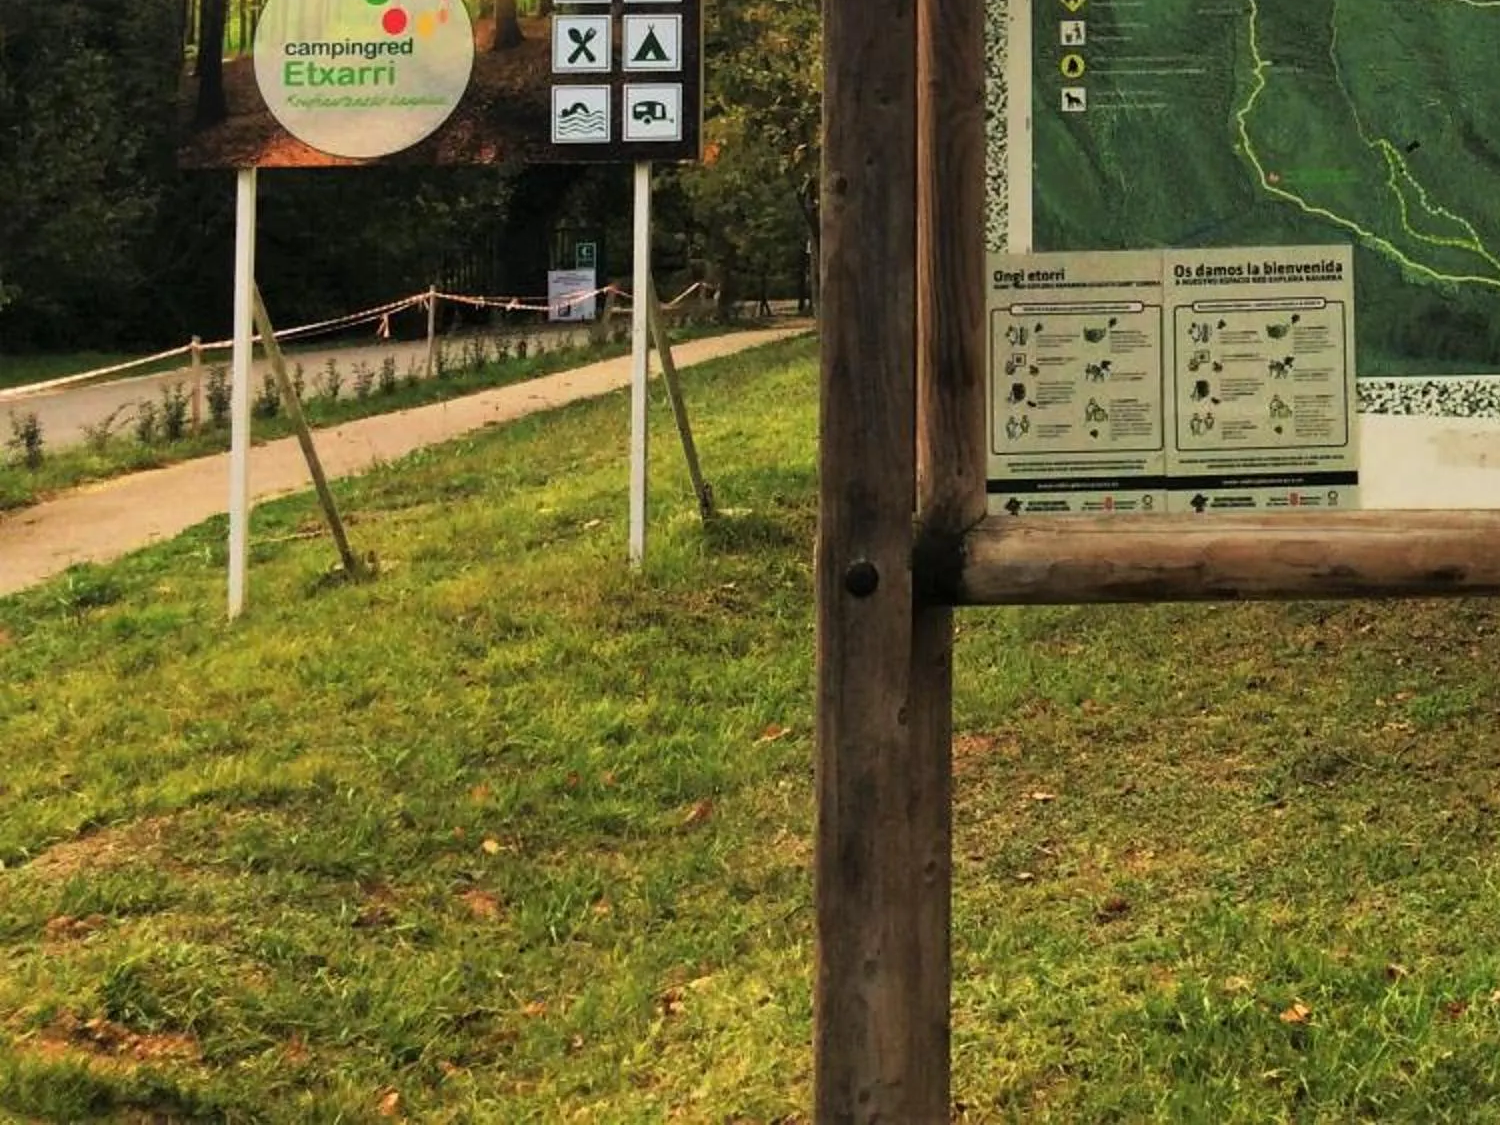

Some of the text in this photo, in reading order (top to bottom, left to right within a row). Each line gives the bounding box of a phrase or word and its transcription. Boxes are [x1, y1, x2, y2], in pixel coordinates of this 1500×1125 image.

[284, 37, 414, 60] campingred
[282, 62, 396, 88] Etxarri
[1027, 269, 1065, 281] etorri
[1195, 262, 1244, 277] damos
[1247, 262, 1262, 276] la
[1264, 260, 1344, 275] bienvenida
